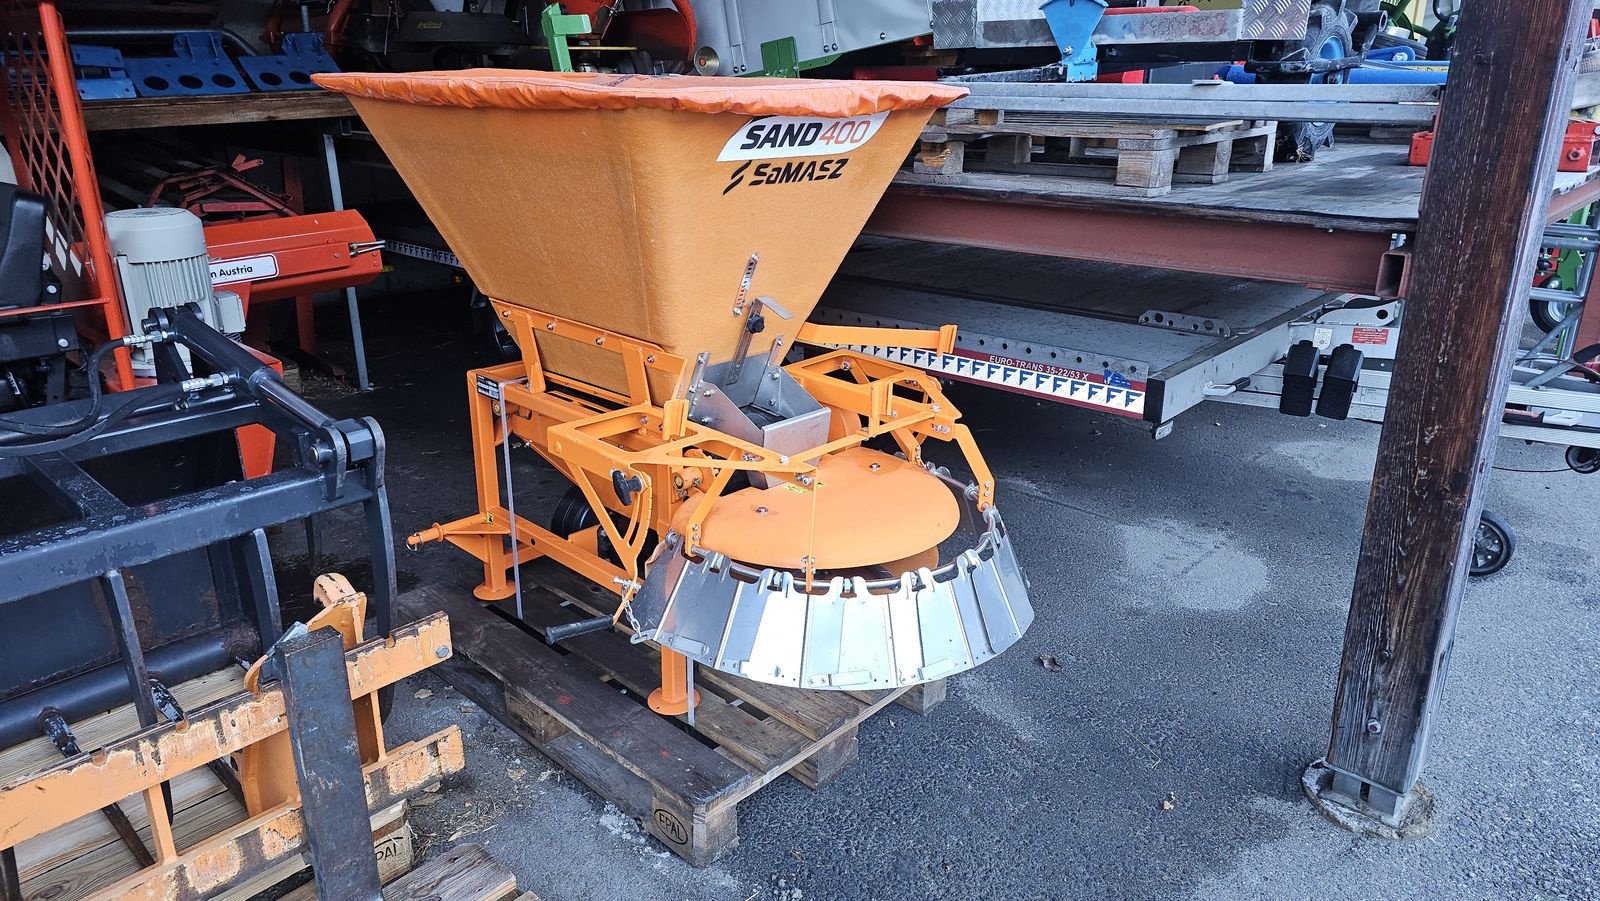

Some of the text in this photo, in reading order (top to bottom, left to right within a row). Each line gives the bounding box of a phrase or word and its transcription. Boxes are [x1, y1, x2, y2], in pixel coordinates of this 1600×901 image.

[219, 265, 253, 277] Austria
[990, 355, 1089, 381] EURO-TRANS 35-22/53 X
[659, 812, 684, 842] EPAL
